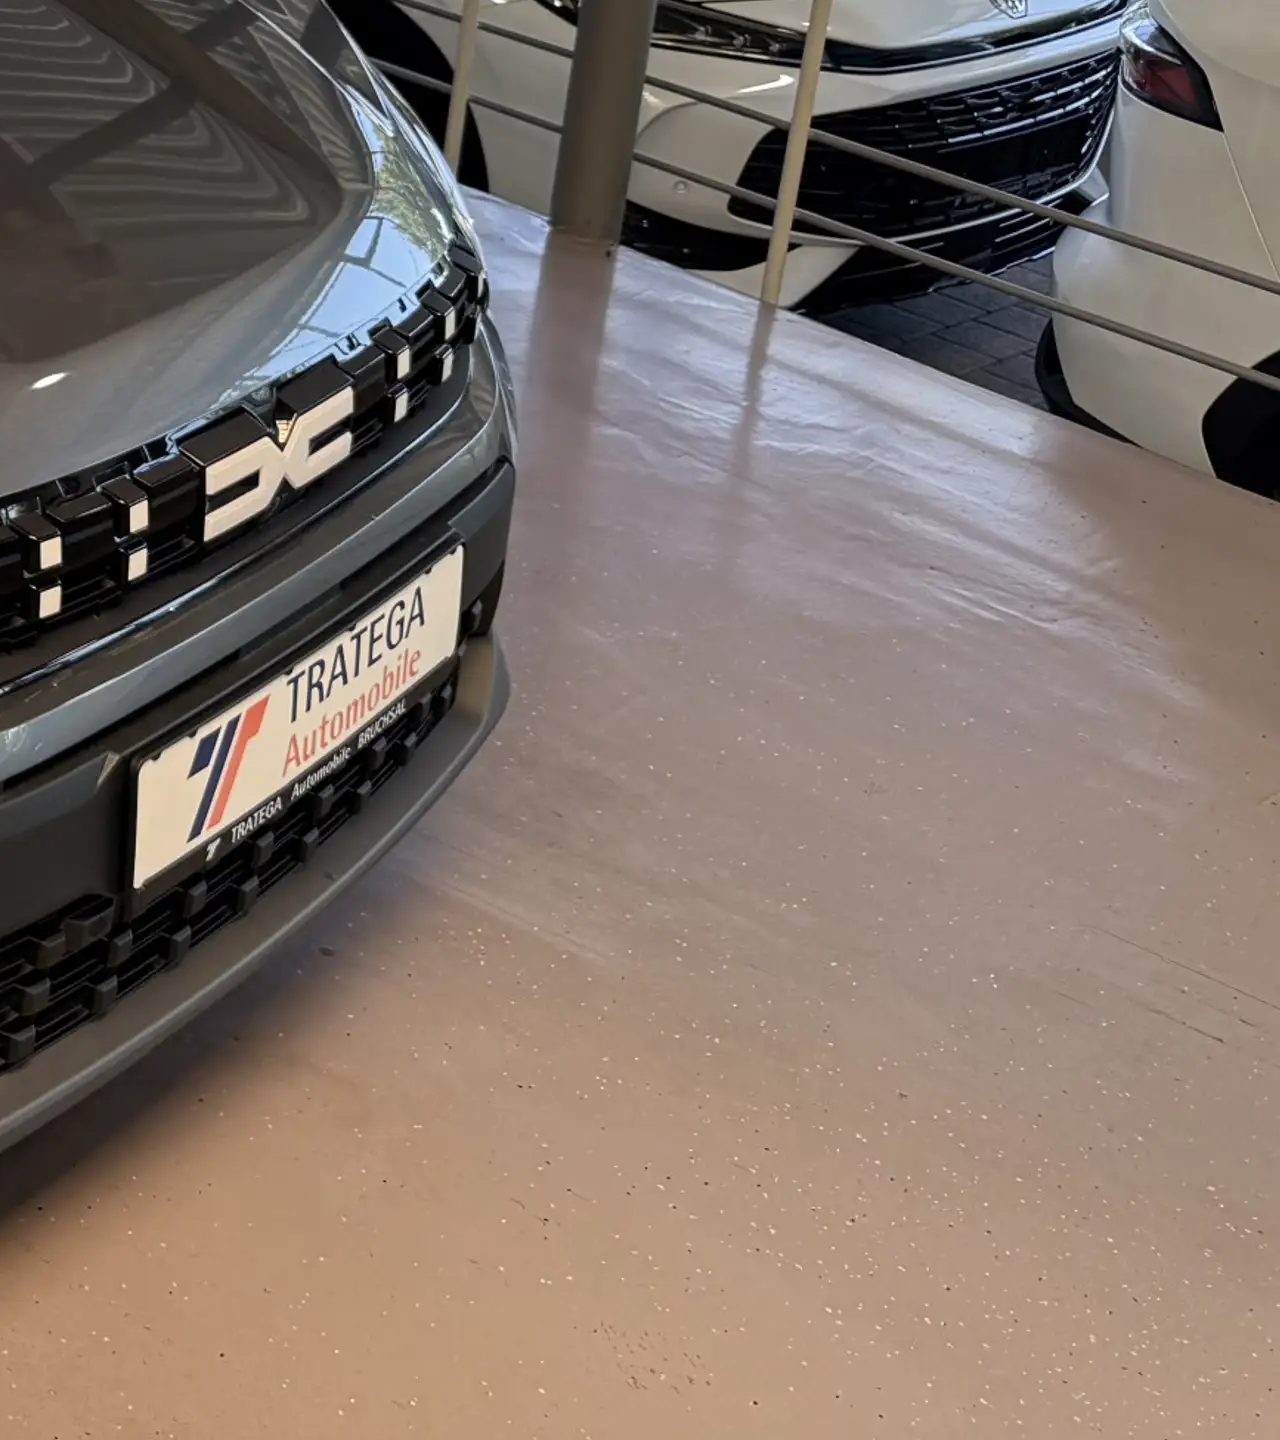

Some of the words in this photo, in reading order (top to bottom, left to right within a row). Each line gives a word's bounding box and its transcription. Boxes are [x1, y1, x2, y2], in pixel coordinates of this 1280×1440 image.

[282, 648, 421, 778] Automobile
[287, 585, 425, 723] TRATEGA
[231, 796, 283, 843] TRATEGA
[290, 746, 351, 801] Automobile
[357, 698, 407, 748] BRUCHSAL
